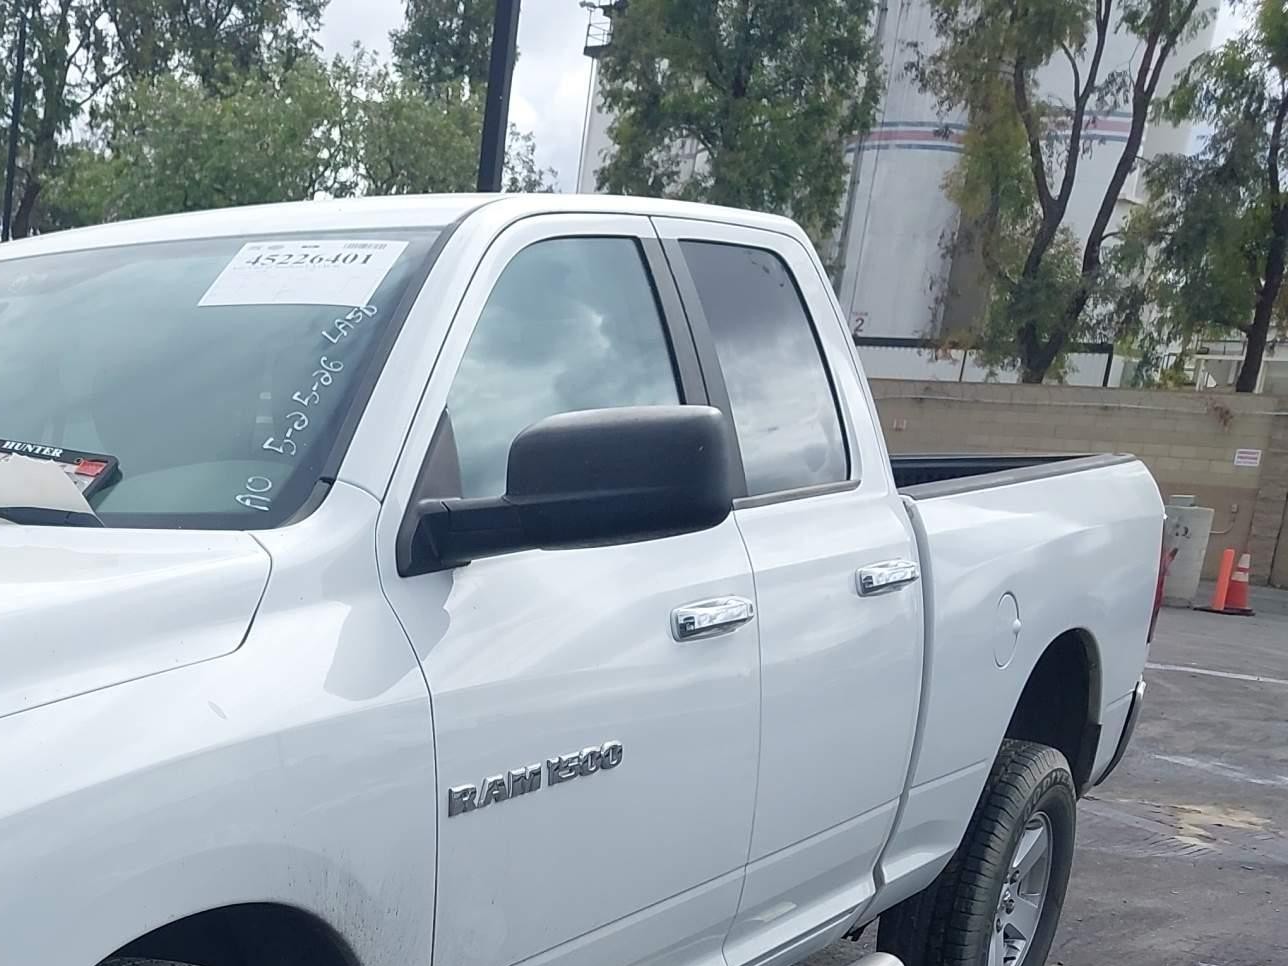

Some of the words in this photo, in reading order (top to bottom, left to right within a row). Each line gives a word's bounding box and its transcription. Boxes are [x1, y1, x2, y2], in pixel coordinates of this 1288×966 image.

[245, 253, 374, 266] 45226401
[2, 440, 63, 458] HUNTER
[448, 763, 542, 818] RAM
[546, 740, 624, 787] 1500
